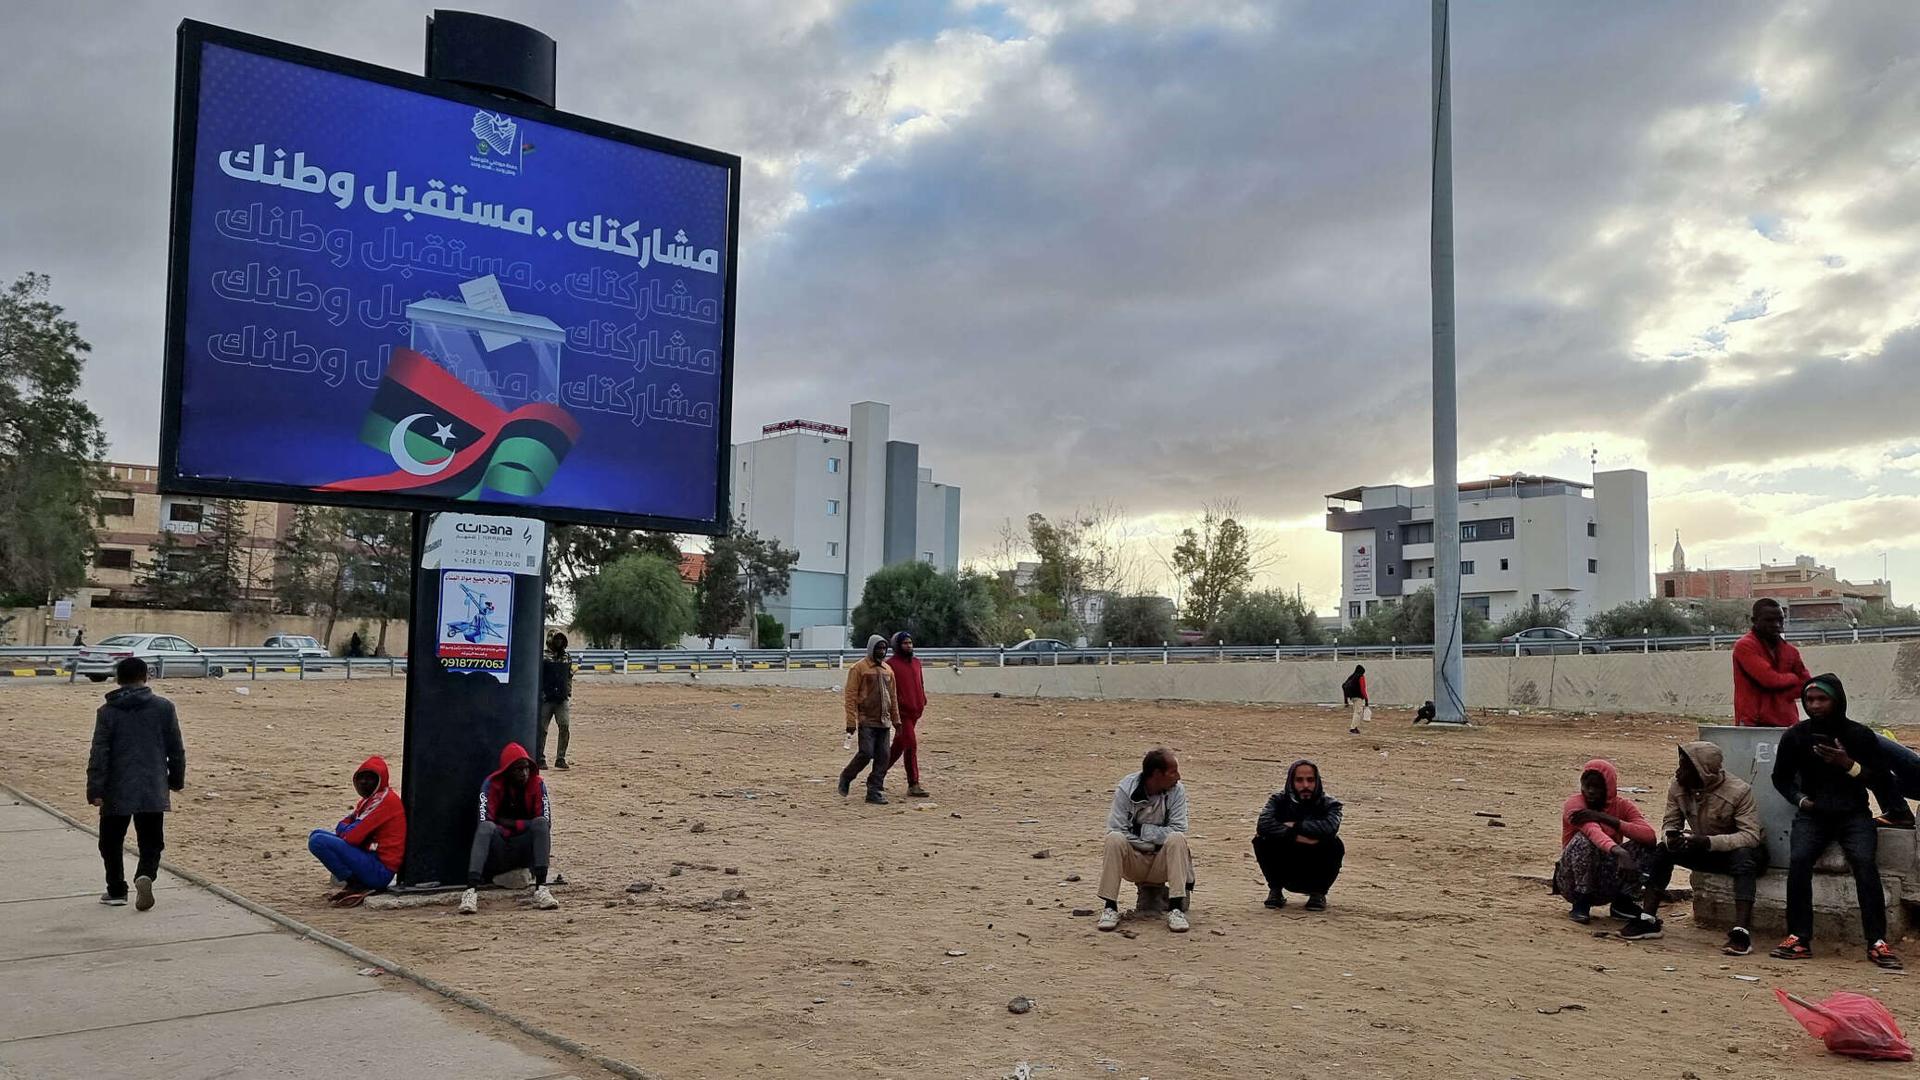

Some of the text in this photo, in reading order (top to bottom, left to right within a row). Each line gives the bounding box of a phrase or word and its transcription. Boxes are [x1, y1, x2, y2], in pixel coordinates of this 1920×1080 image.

[218, 143, 355, 210] وطنك
[214, 202, 353, 268] وطنك
[211, 263, 351, 326] وطنك
[207, 325, 348, 388] وطنك
[440, 657, 505, 669] 0918777063
